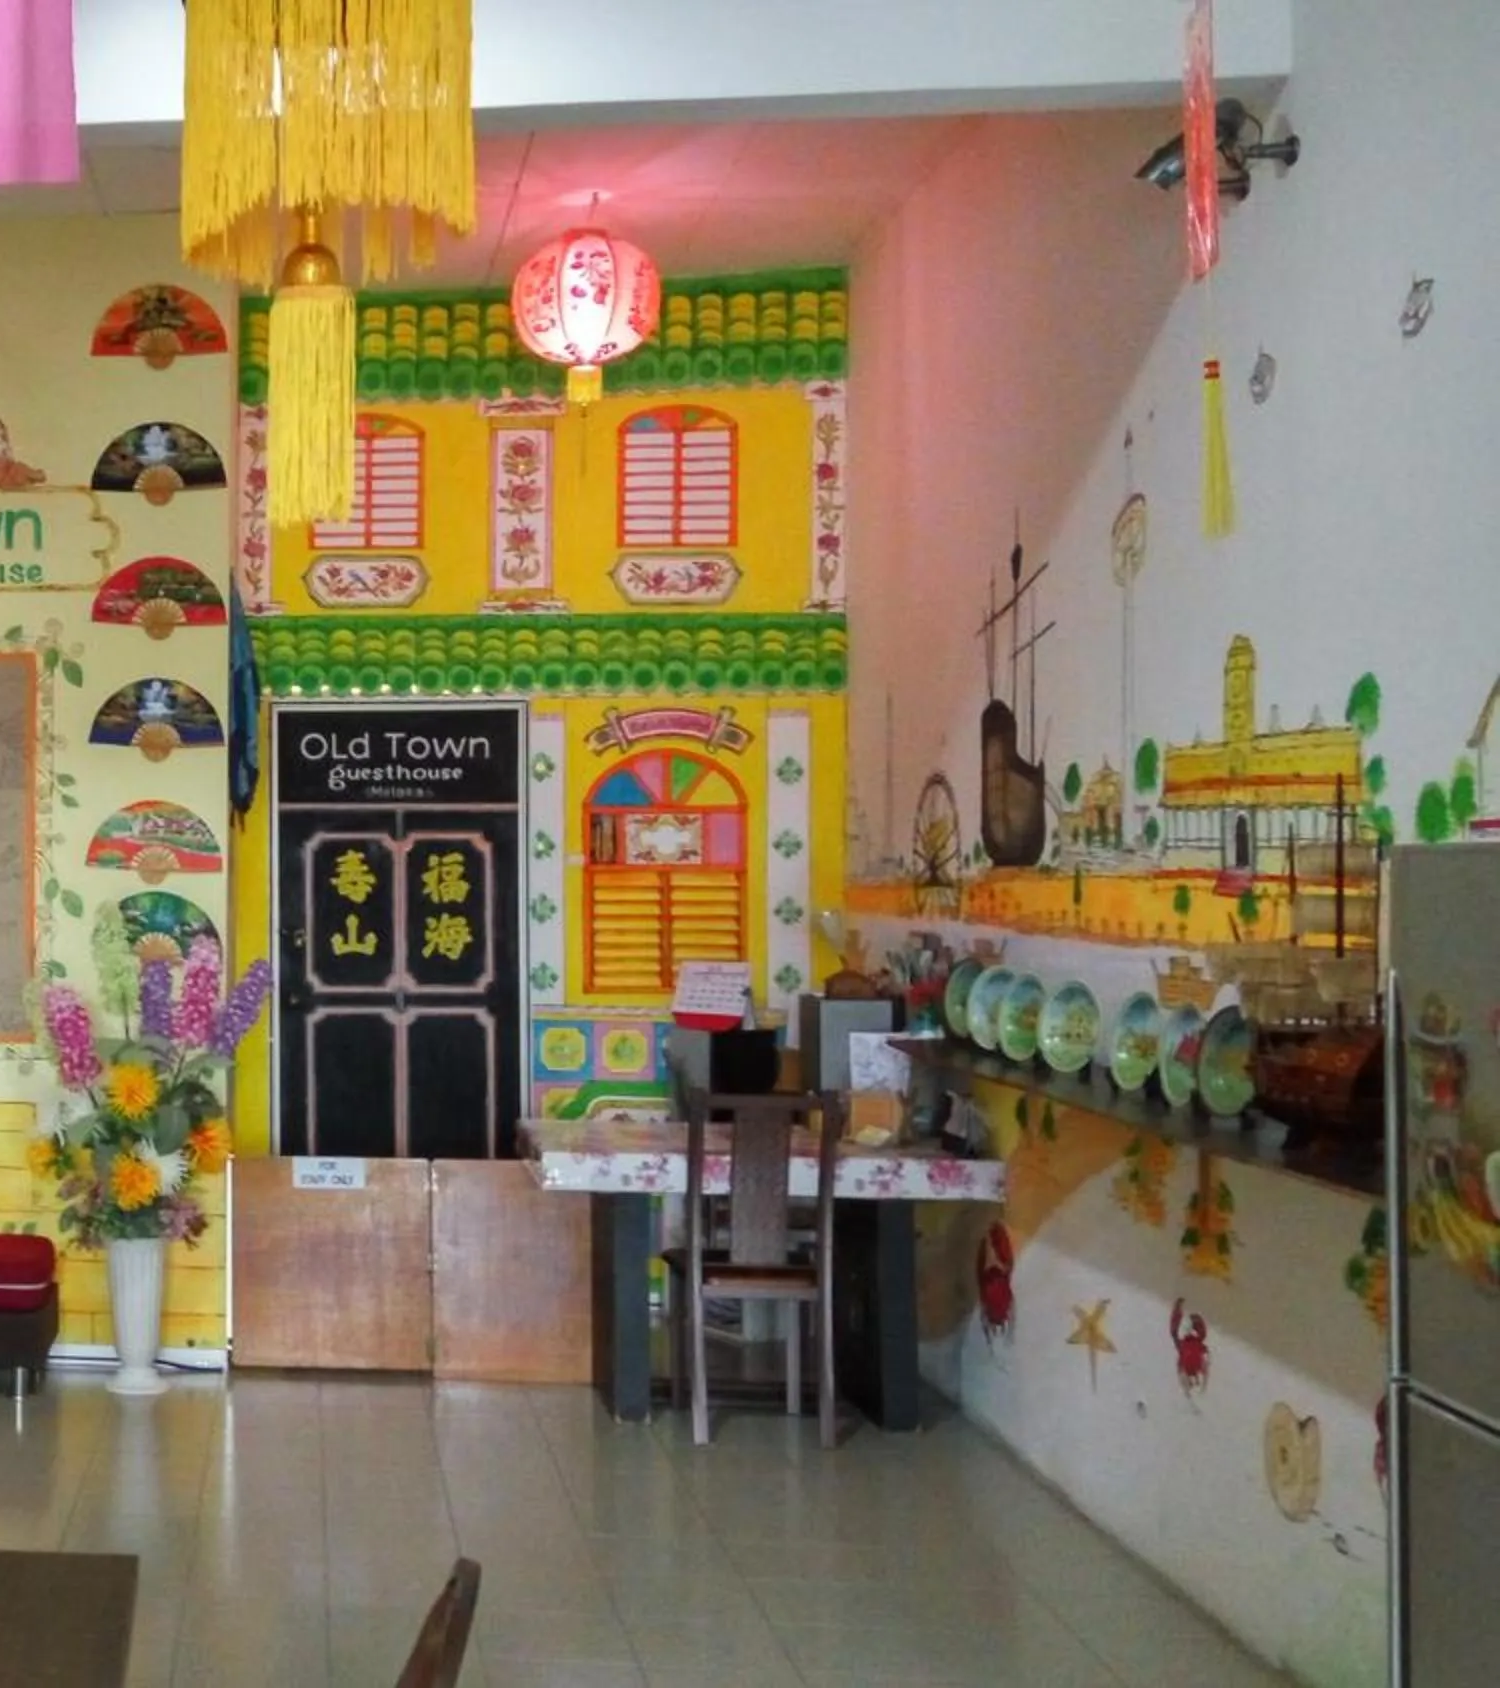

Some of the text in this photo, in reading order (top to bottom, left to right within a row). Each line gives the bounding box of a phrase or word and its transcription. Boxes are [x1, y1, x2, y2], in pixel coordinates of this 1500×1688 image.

[383, 732, 490, 760] Town
[327, 763, 464, 791] guesthouse
[331, 1174, 354, 1185] ONLY
